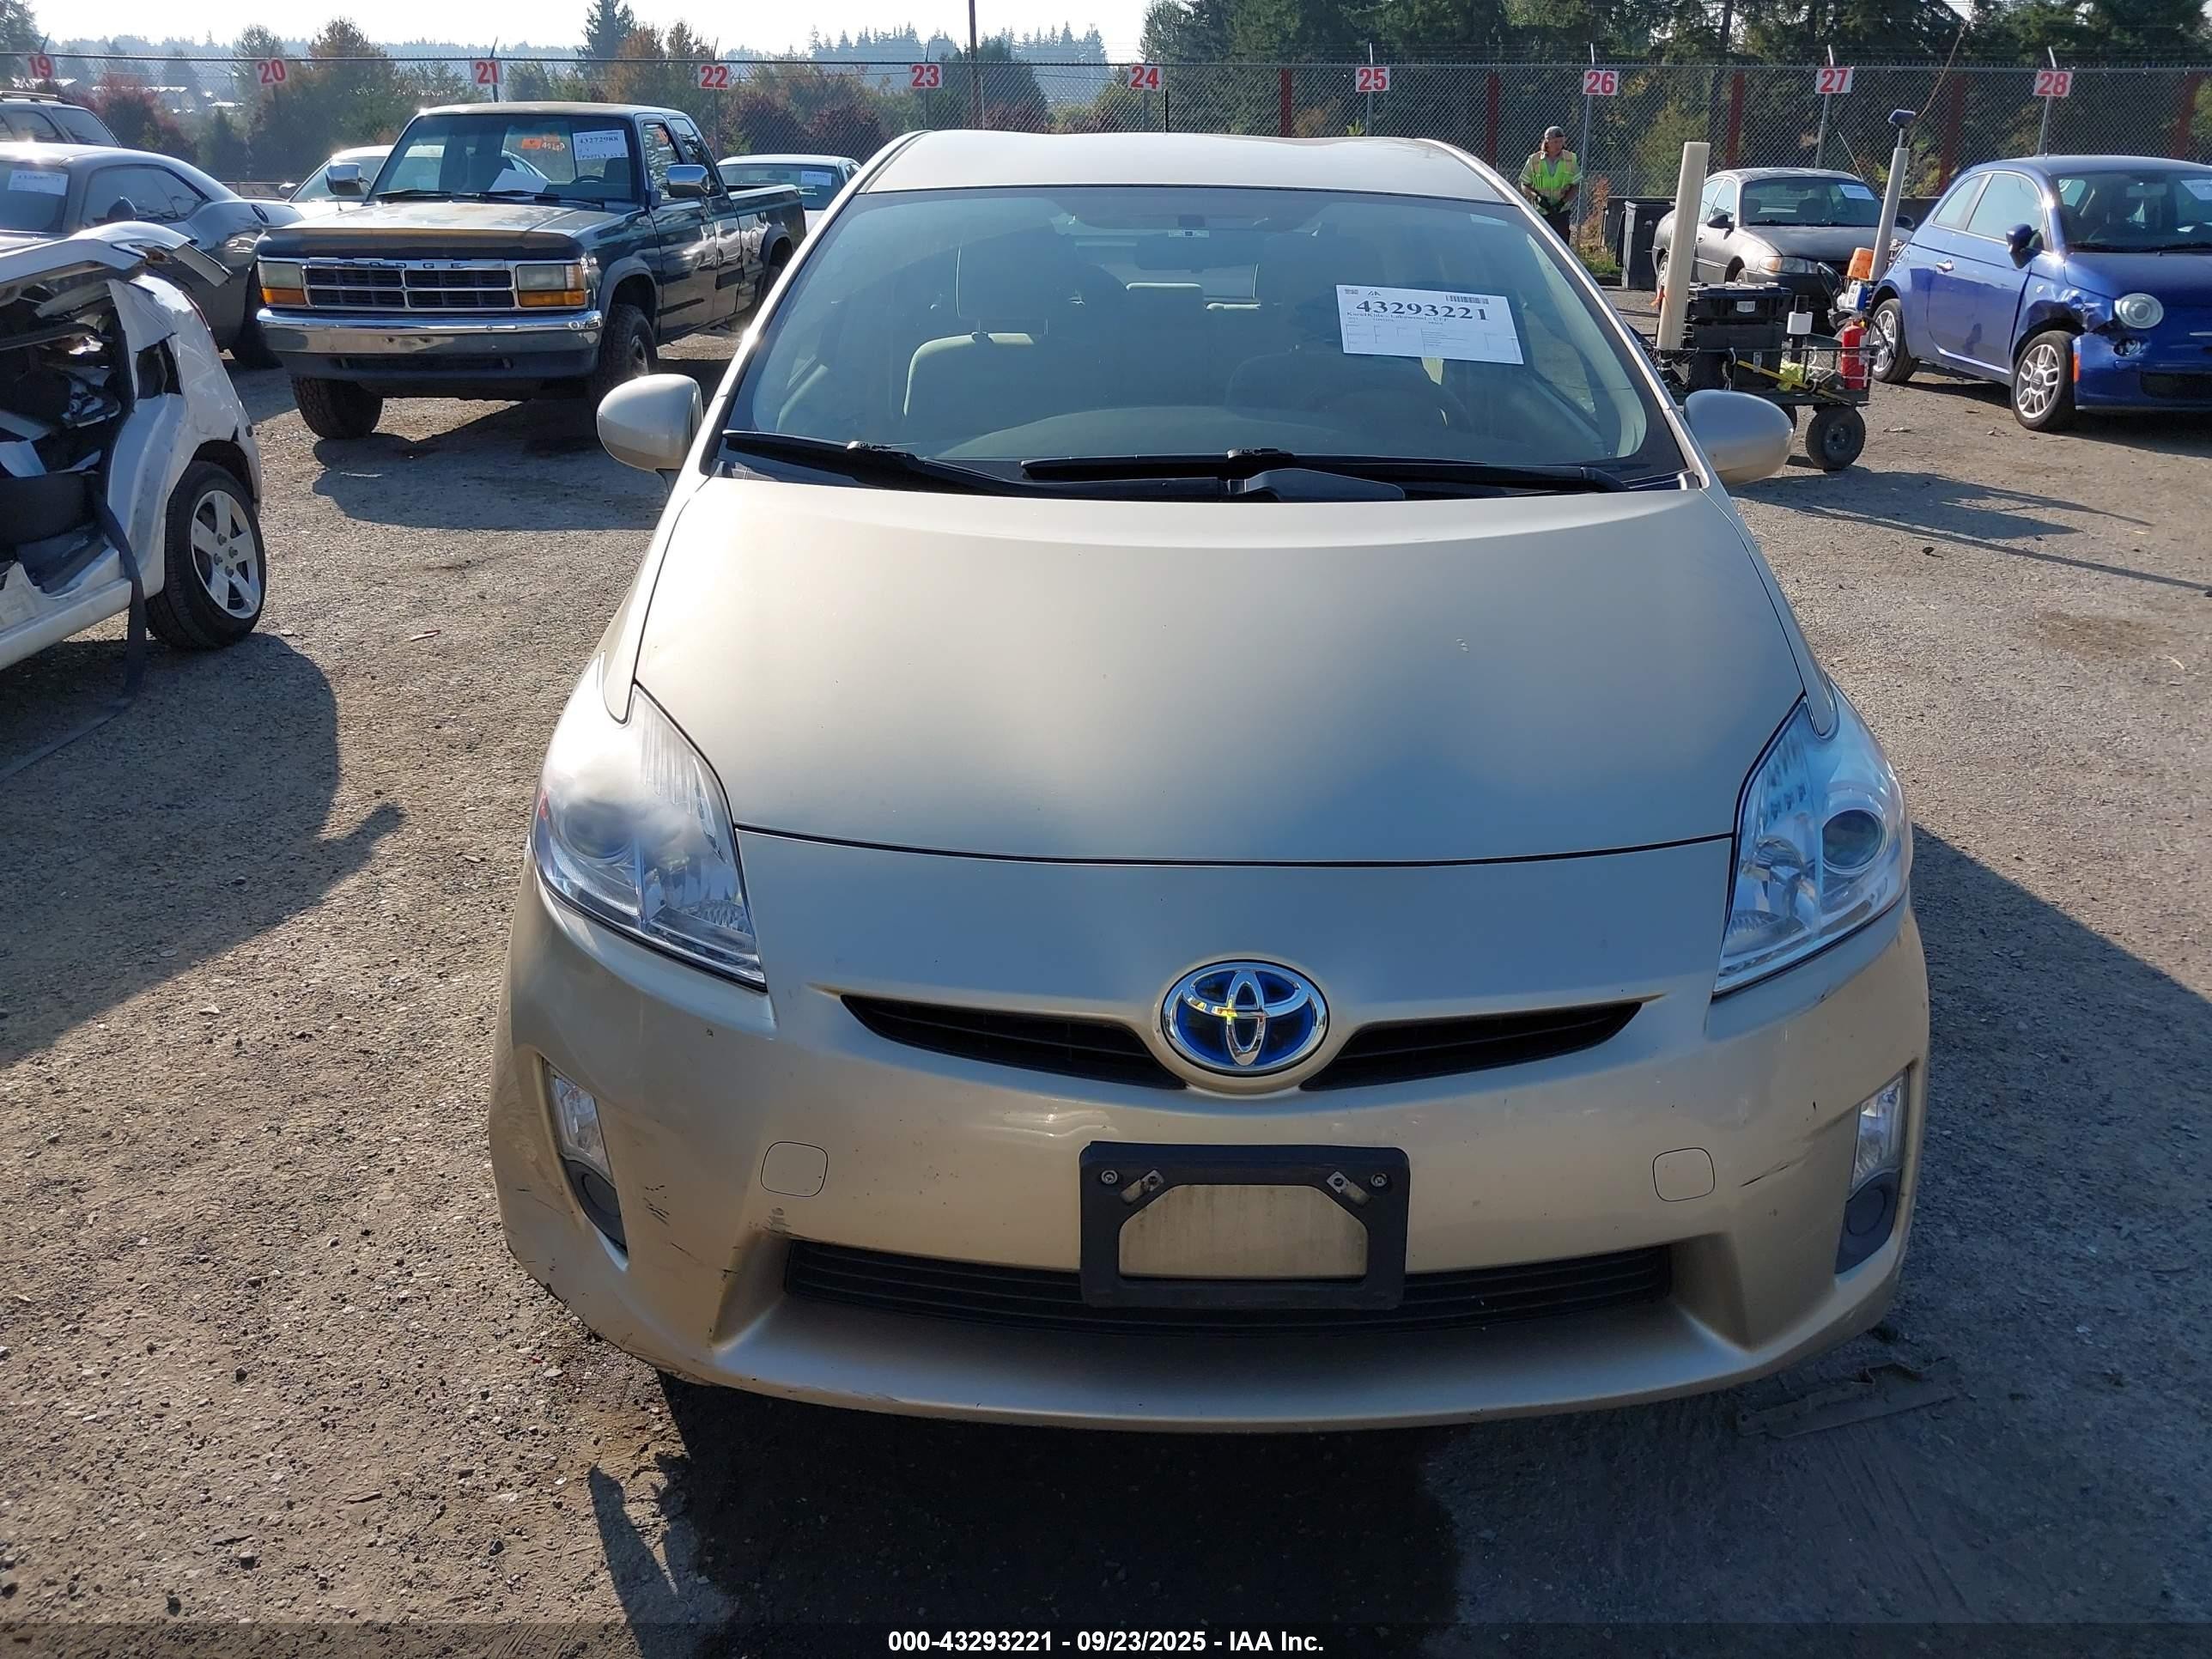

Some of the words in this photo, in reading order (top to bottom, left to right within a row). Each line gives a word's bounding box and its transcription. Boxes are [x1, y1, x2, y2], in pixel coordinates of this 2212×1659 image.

[27, 55, 52, 78] 19
[258, 59, 286, 83] 20
[475, 61, 498, 83] 21
[700, 65, 728, 88] 22
[911, 64, 939, 87] 23
[1130, 65, 1159, 89] 24
[1358, 69, 1387, 91] 25
[1585, 71, 1615, 94] 26
[1820, 69, 1848, 93] 27
[2037, 72, 2069, 95] 28
[343, 261, 463, 270] DODGE
[1356, 300, 1491, 321] 43293221
